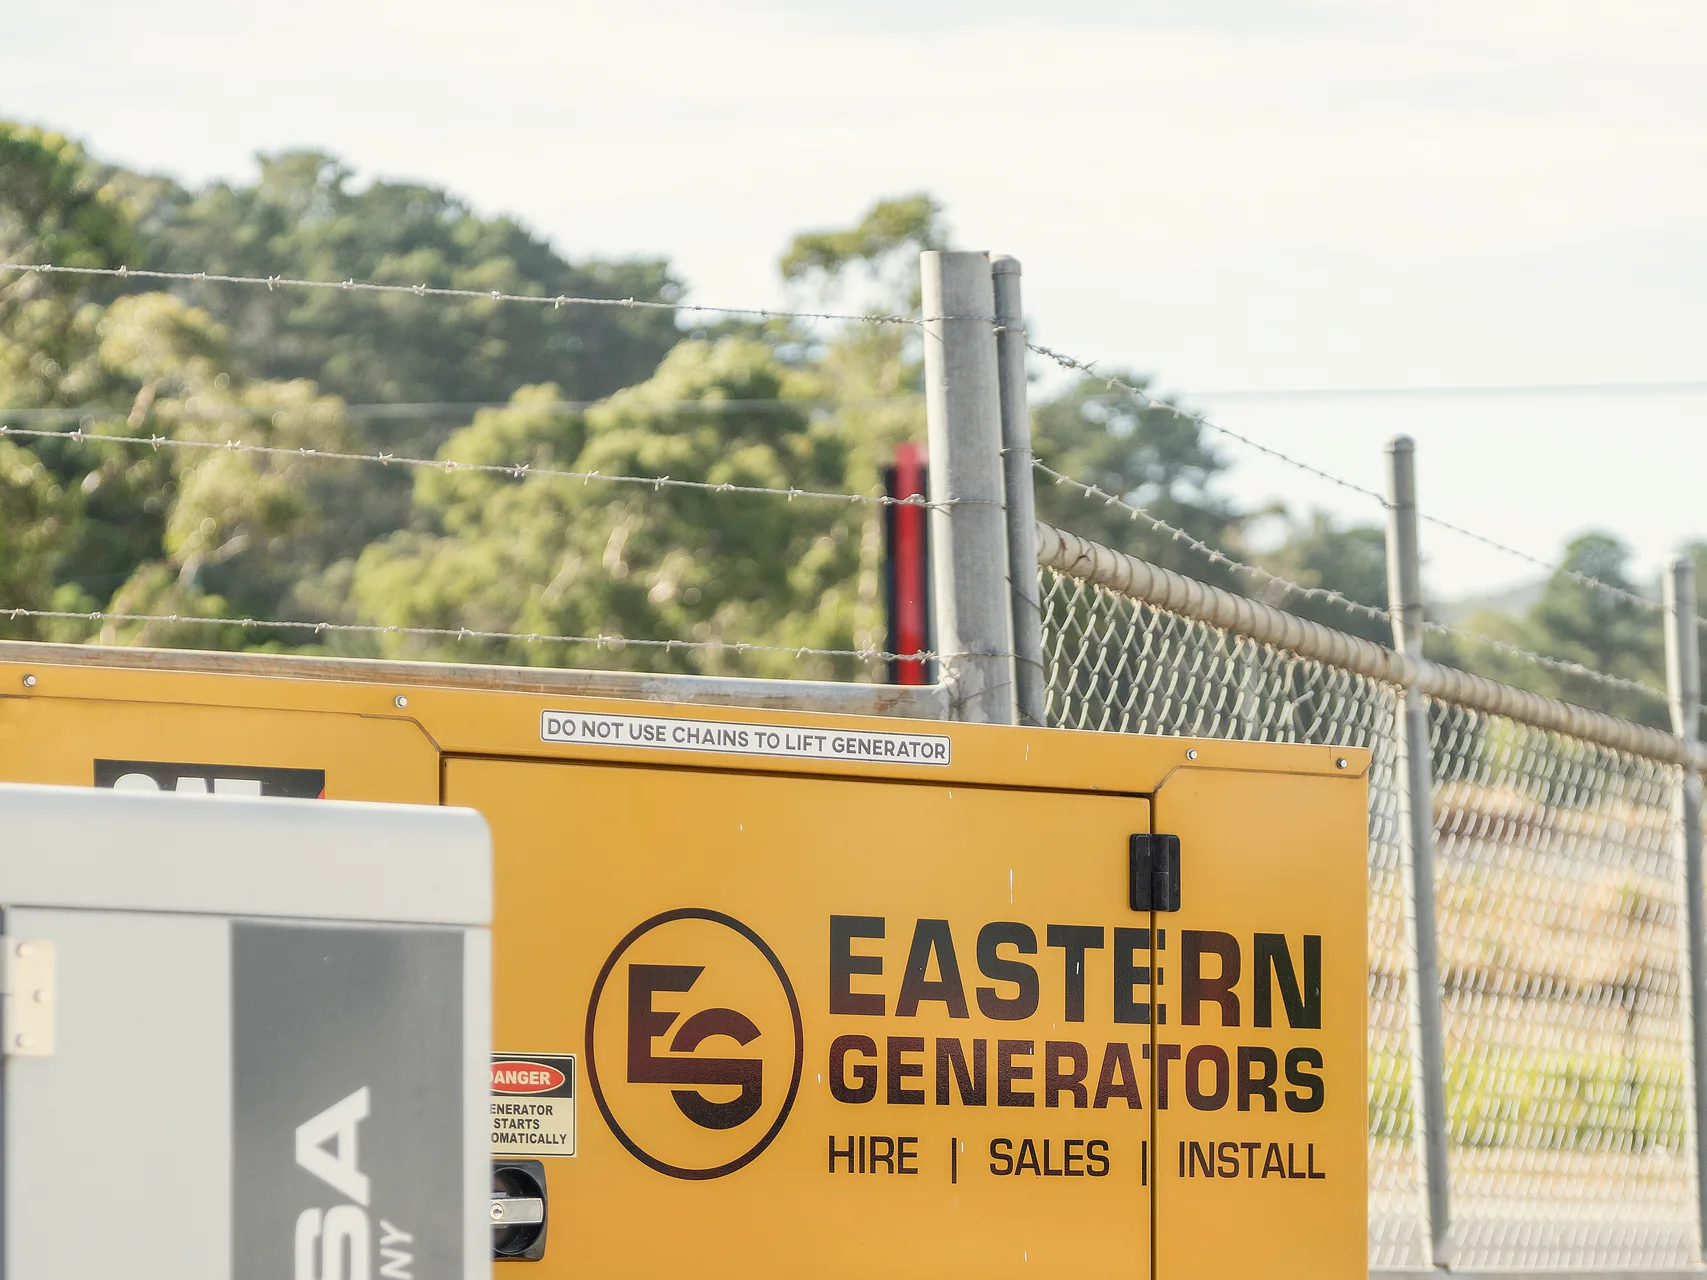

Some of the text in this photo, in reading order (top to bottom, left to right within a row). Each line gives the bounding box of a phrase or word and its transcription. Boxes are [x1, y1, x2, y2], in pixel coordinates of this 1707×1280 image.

[548, 718, 946, 760] DO NOT USE CHAINS TO LIFT GENERATOR
[828, 914, 1322, 1030] EASTERN
[490, 1070, 551, 1085] ANGER
[828, 1034, 1325, 1113] GENERATORS
[490, 1104, 553, 1116] ENERATOR
[493, 1118, 540, 1130] STARTS
[490, 1132, 567, 1145] OMATICALLY
[828, 1135, 1326, 1179] HIRE SALES INSTALL
